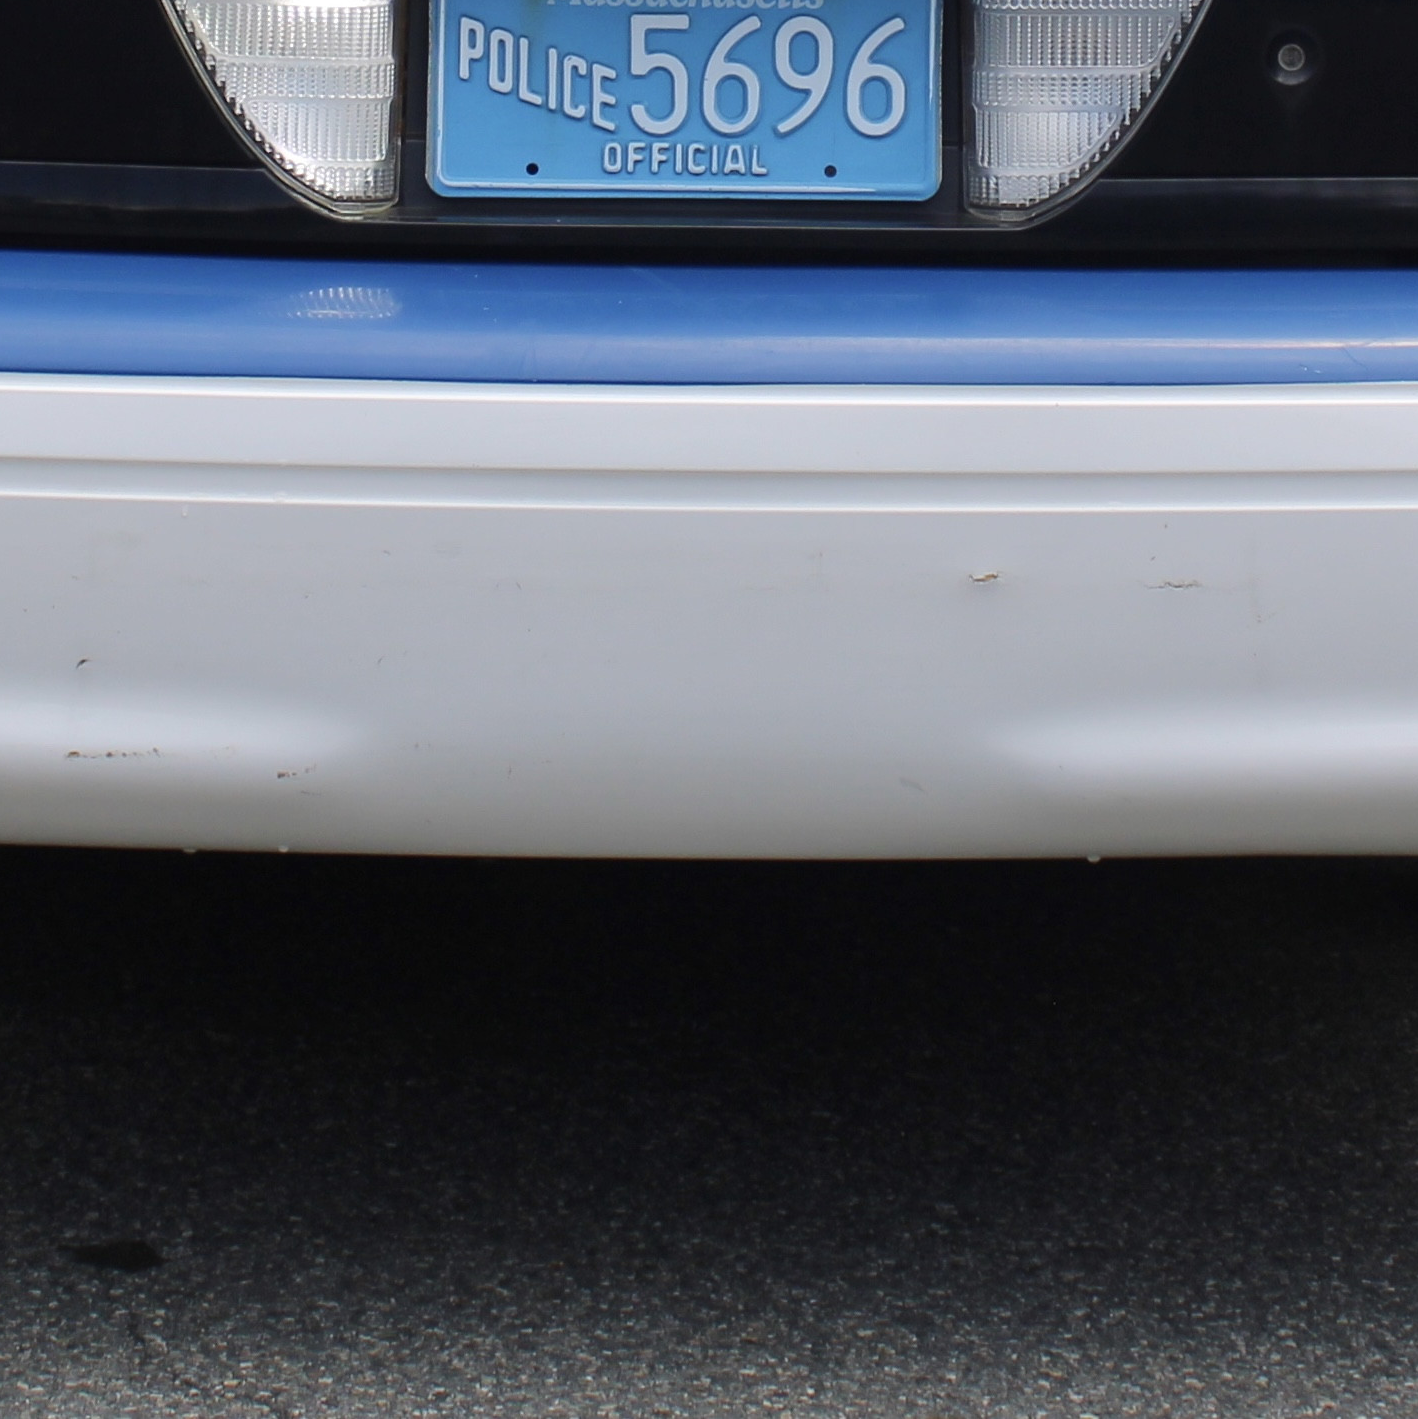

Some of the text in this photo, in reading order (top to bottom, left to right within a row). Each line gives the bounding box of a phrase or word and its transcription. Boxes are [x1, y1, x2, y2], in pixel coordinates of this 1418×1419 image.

[458, 13, 907, 138] POLICE 5696
[602, 141, 769, 177] OFFICIAL
